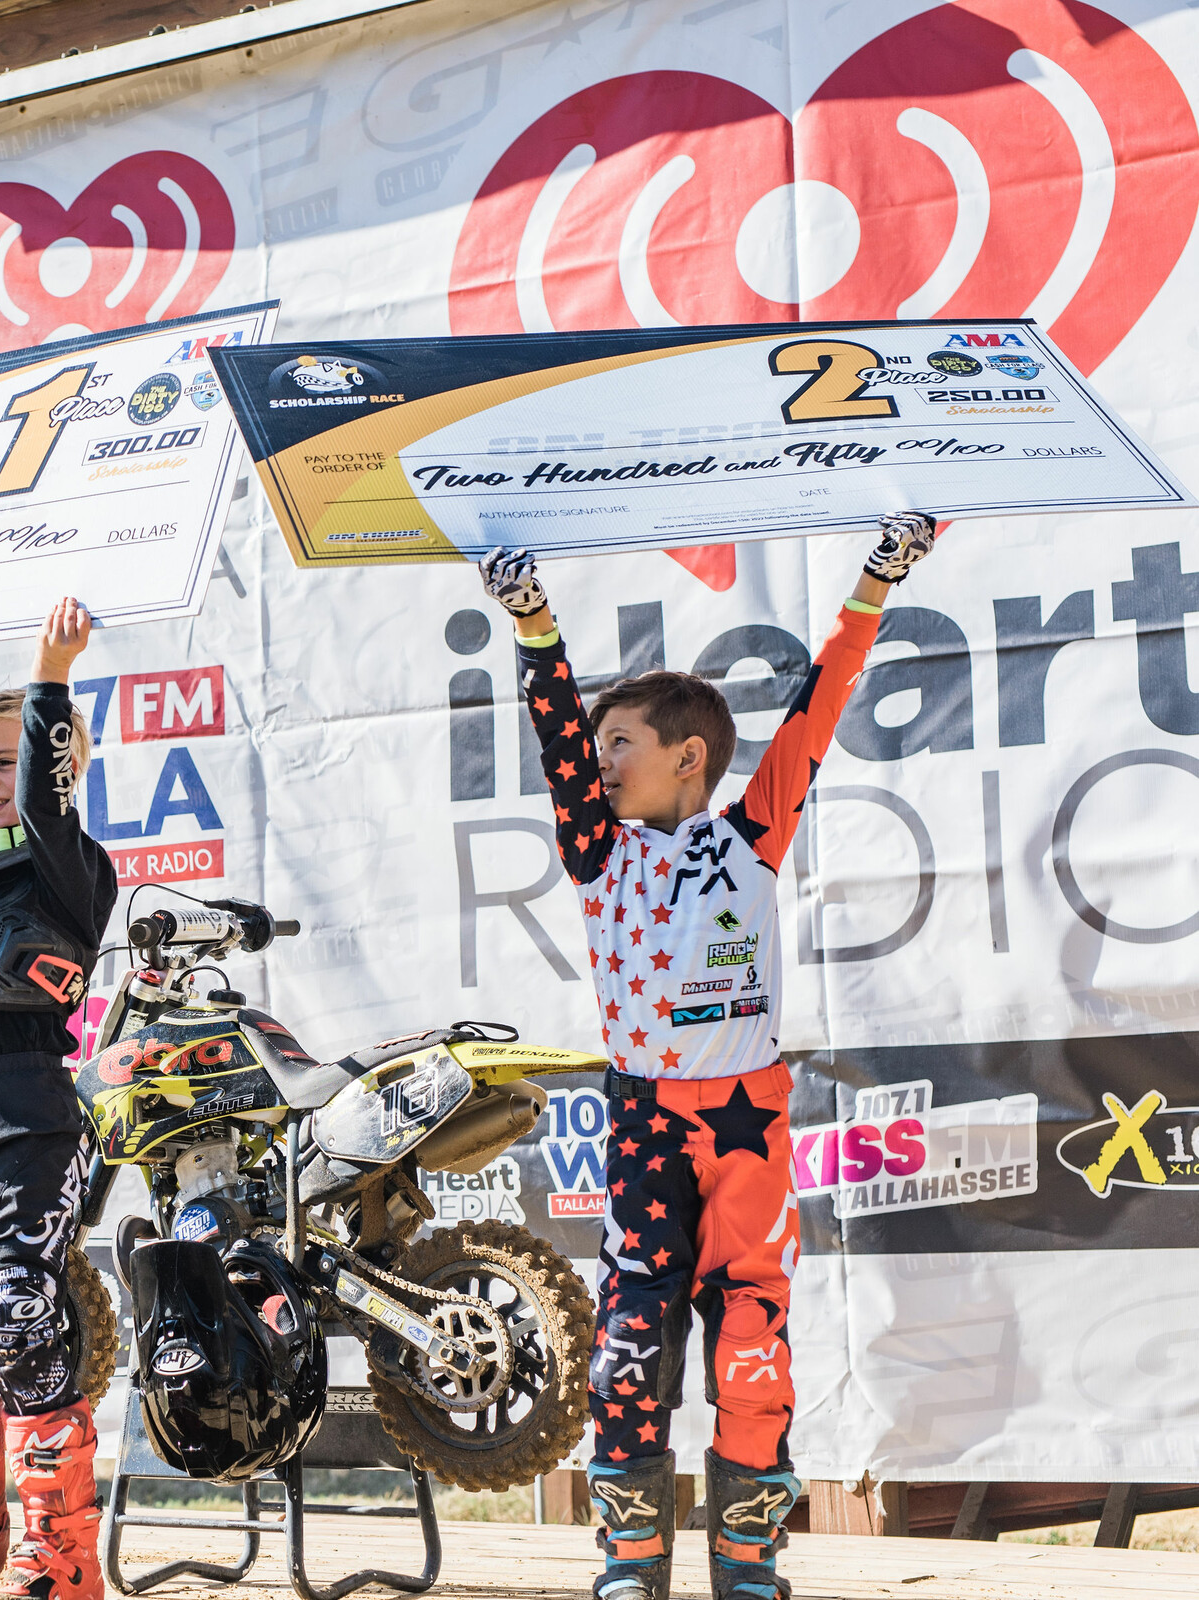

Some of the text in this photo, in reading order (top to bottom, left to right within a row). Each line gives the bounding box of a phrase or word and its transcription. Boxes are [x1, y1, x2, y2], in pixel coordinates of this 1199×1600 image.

[944, 334, 1027, 347] AMA
[930, 357, 977, 370] DIRTY
[87, 373, 114, 389] ST
[768, 339, 912, 425] 2 ND
[857, 367, 948, 388] Place
[130, 390, 180, 406] DIRTY
[269, 393, 405, 409] SCHOLARSHIP RACE
[927, 389, 1046, 402] 250.00
[49, 395, 126, 428] Place
[137, 403, 165, 414] 100
[946, 405, 1055, 415] Scholarship
[87, 427, 201, 462] 300.00
[88, 455, 189, 482] Scholarship
[304, 451, 386, 464] PAY TO THE
[312, 461, 386, 474] ORDER OF
[413, 462, 513, 490] Two
[522, 456, 718, 488] Hundred
[724, 455, 782, 473] and
[783, 440, 889, 469] Fifty
[895, 437, 1005, 457] 00/100
[1022, 446, 1103, 458] DOLLARS
[478, 488, 832, 520] AUTHORIZED SIGNATURE DATE
[107, 522, 178, 543] DOLLARS
[133, 677, 215, 732] FM
[147, 848, 213, 875] RADIO
[453, 748, 1199, 988] RDIO
[508, 1050, 571, 1058] DUNLOP
[187, 1093, 255, 1118] ELITE
[188, 1104, 253, 1121] FACTORY RACING
[862, 1086, 926, 1119] 107.1
[792, 1101, 1031, 1190] KISS FM
[421, 1164, 515, 1192] Heart
[839, 1162, 1031, 1211] TALLAHASSEE
[432, 1194, 520, 1220] EDIA
[190, 1222, 211, 1238] BUILT
